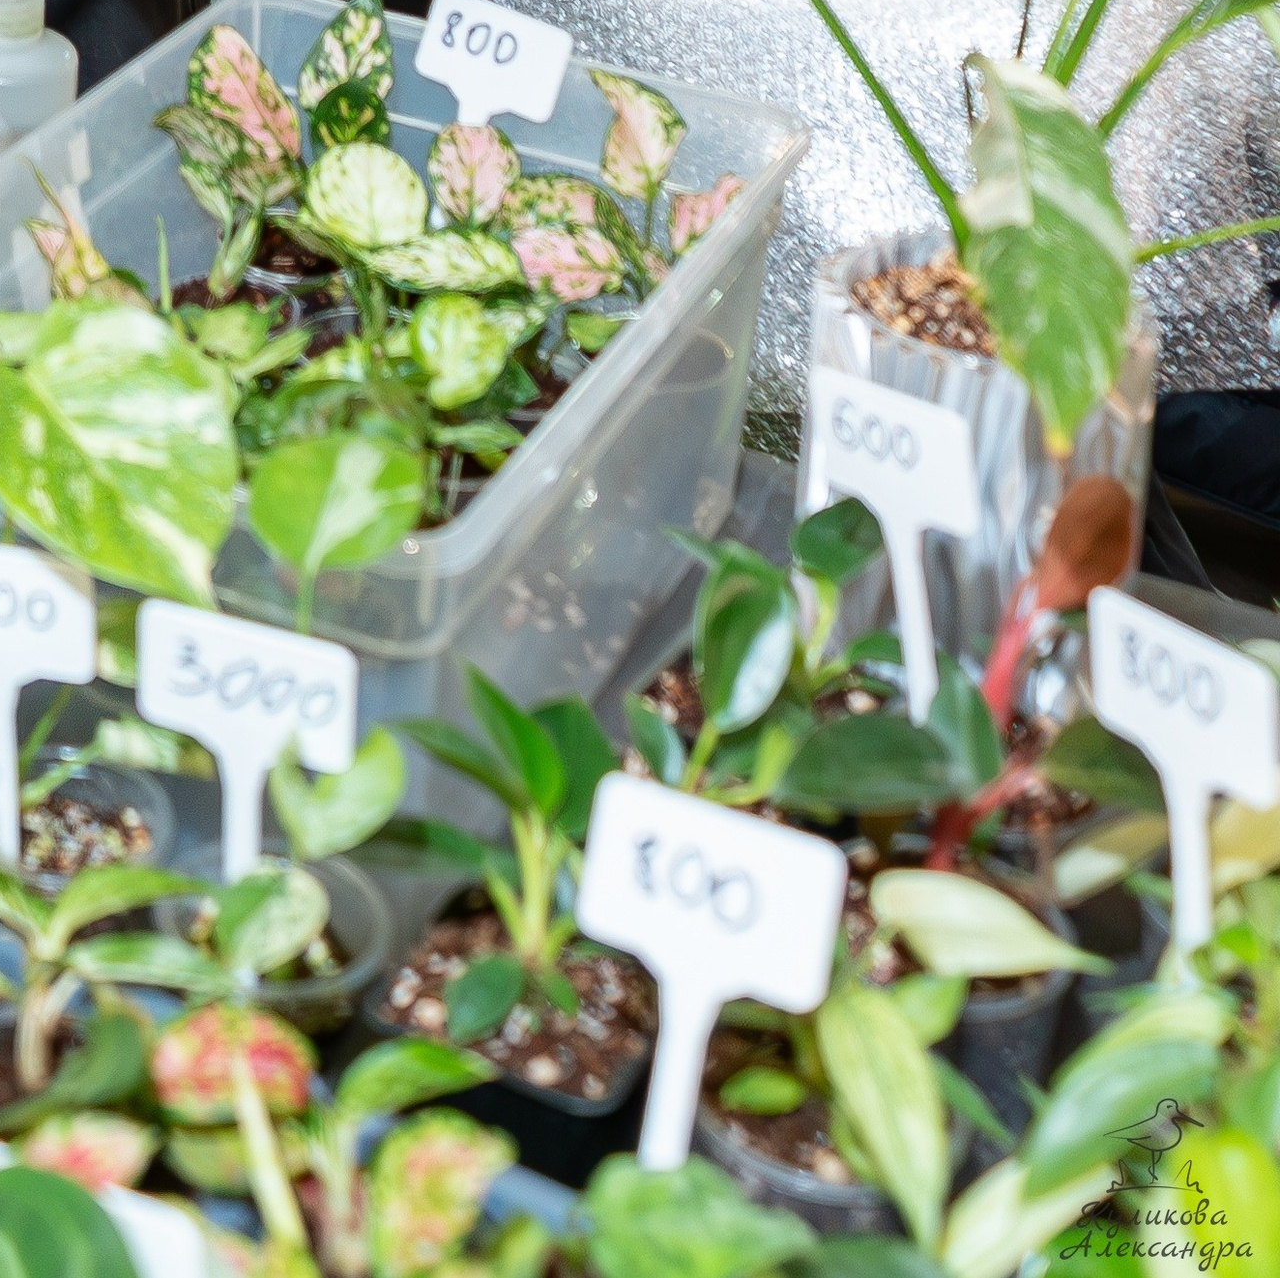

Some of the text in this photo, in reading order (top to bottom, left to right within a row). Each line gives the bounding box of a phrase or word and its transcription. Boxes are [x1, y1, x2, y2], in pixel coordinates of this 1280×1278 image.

[442, 10, 518, 64] 800
[831, 396, 920, 471] 600
[170, 633, 339, 727] 3000
